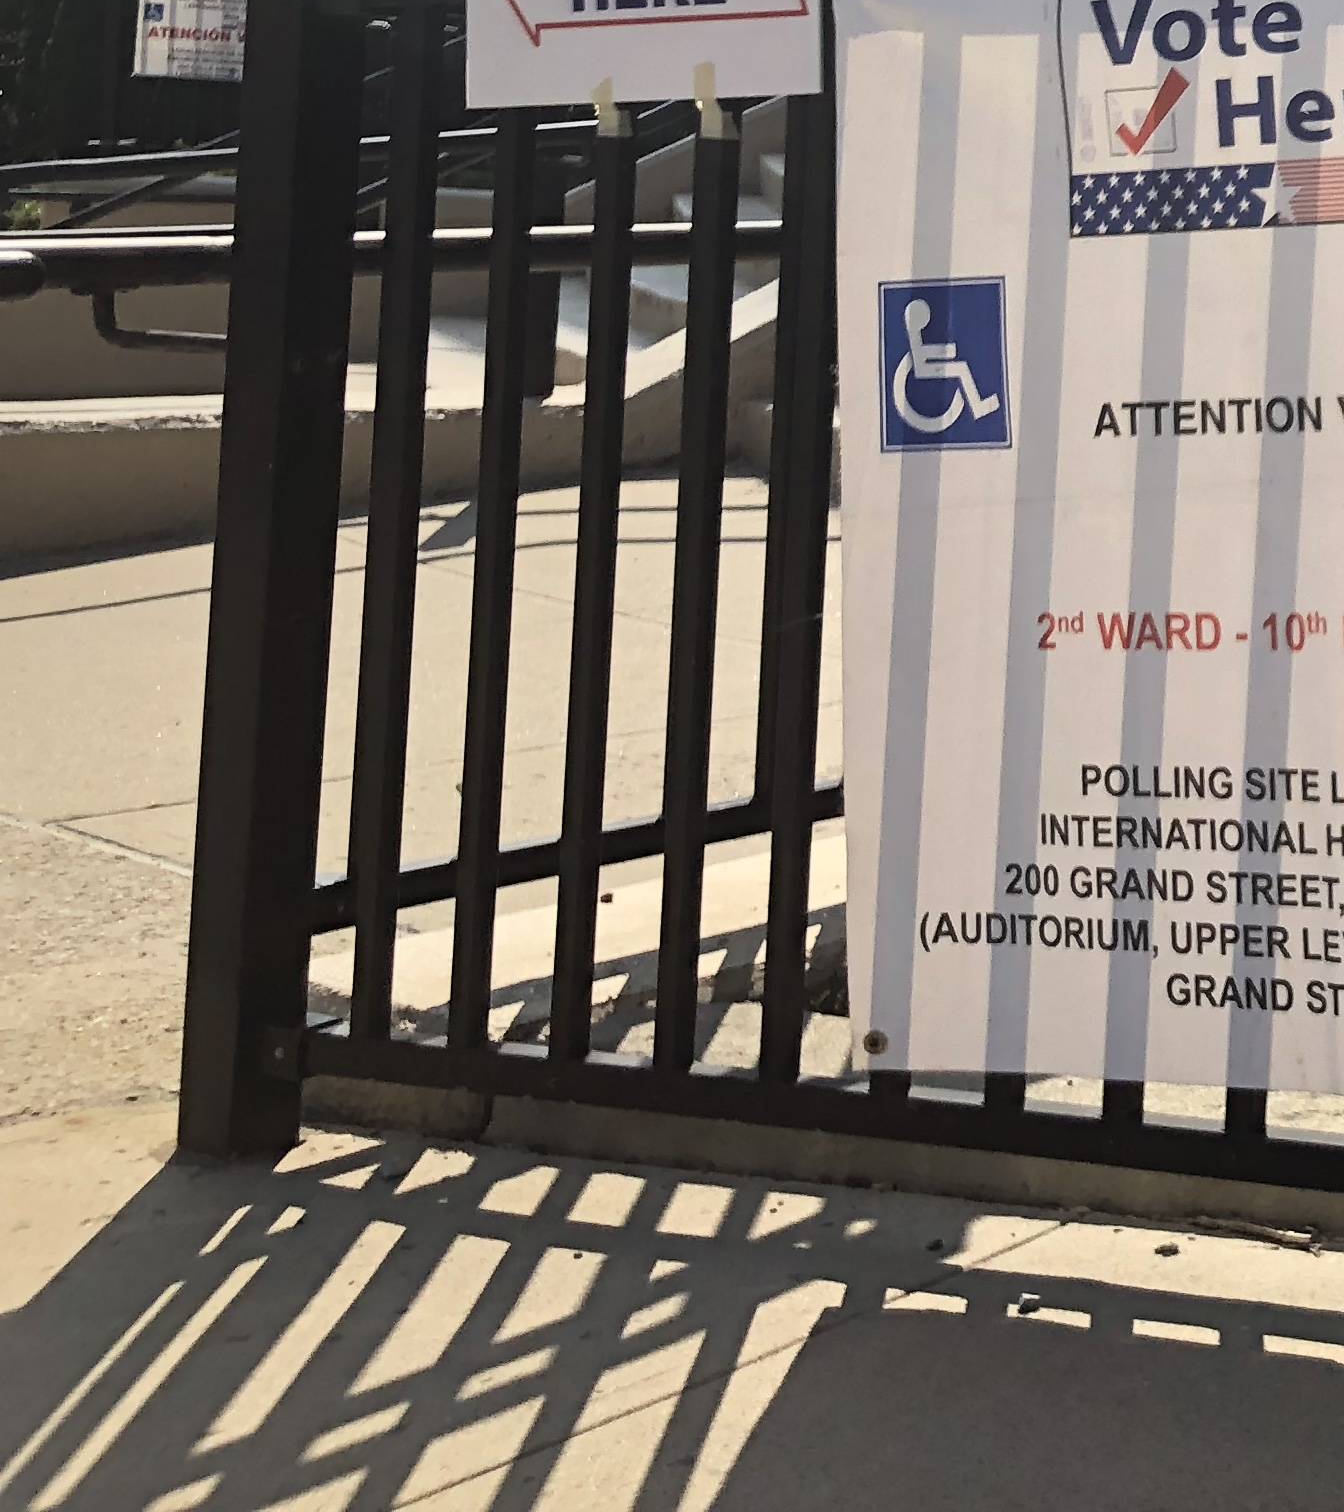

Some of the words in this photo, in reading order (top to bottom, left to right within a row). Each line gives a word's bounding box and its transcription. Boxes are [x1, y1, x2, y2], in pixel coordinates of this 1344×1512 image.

[1093, 395, 1322, 438] ATTENTION
[1036, 610, 1085, 652] 2nd
[1097, 612, 1222, 651] WARD
[1234, 632, 1249, 642] -
[1262, 610, 1328, 652] 10th
[1080, 763, 1234, 800] POLLING
[1245, 766, 1321, 803] SITE
[1040, 813, 1318, 855] INTERNATIONAL
[1004, 863, 1060, 897] 200
[1070, 865, 1194, 902] GRAND
[920, 911, 1159, 959] (AUDITORIUM,
[1170, 921, 1292, 960] UPPER
[1166, 973, 1294, 1012] GRAND
